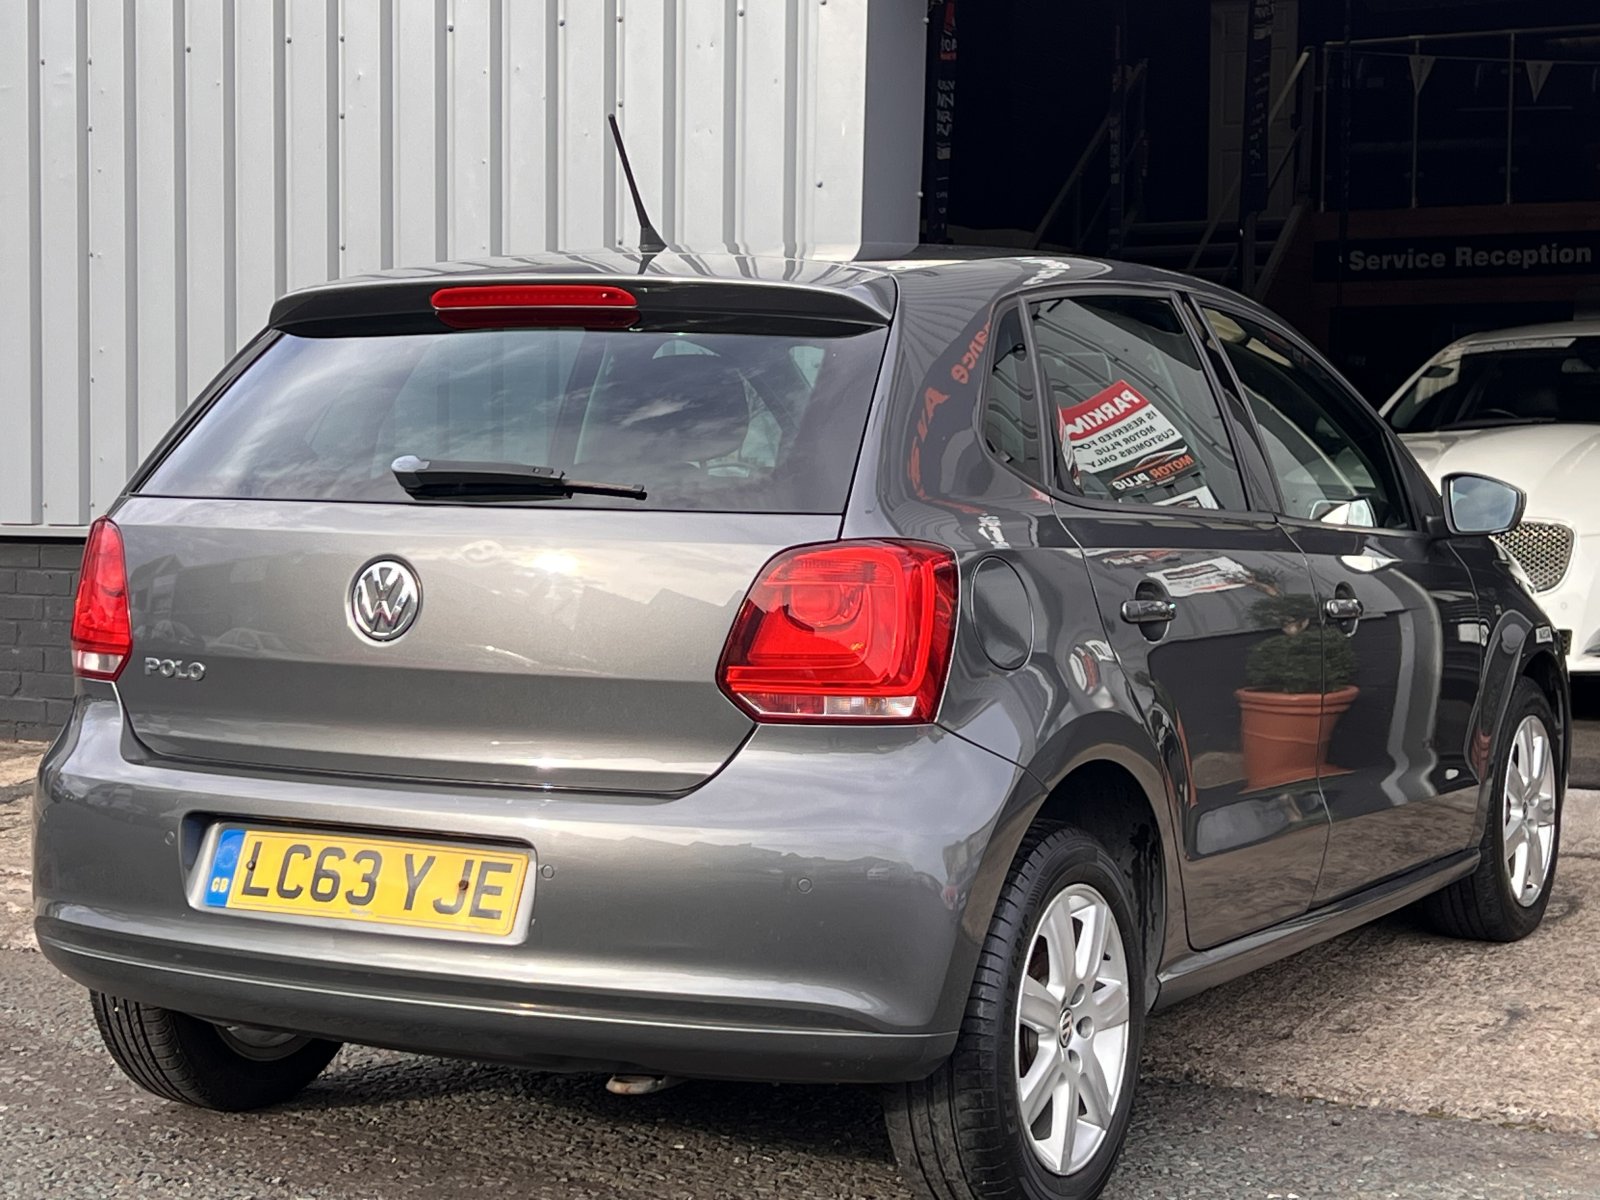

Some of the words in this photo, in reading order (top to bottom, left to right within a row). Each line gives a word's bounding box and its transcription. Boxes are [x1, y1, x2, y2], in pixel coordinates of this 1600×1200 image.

[1349, 249, 1446, 271] Service
[1455, 243, 1592, 269] Reception
[144, 656, 206, 681] POLO
[211, 876, 230, 893] GB
[241, 841, 383, 906] LC63
[403, 853, 514, 920] YJE
